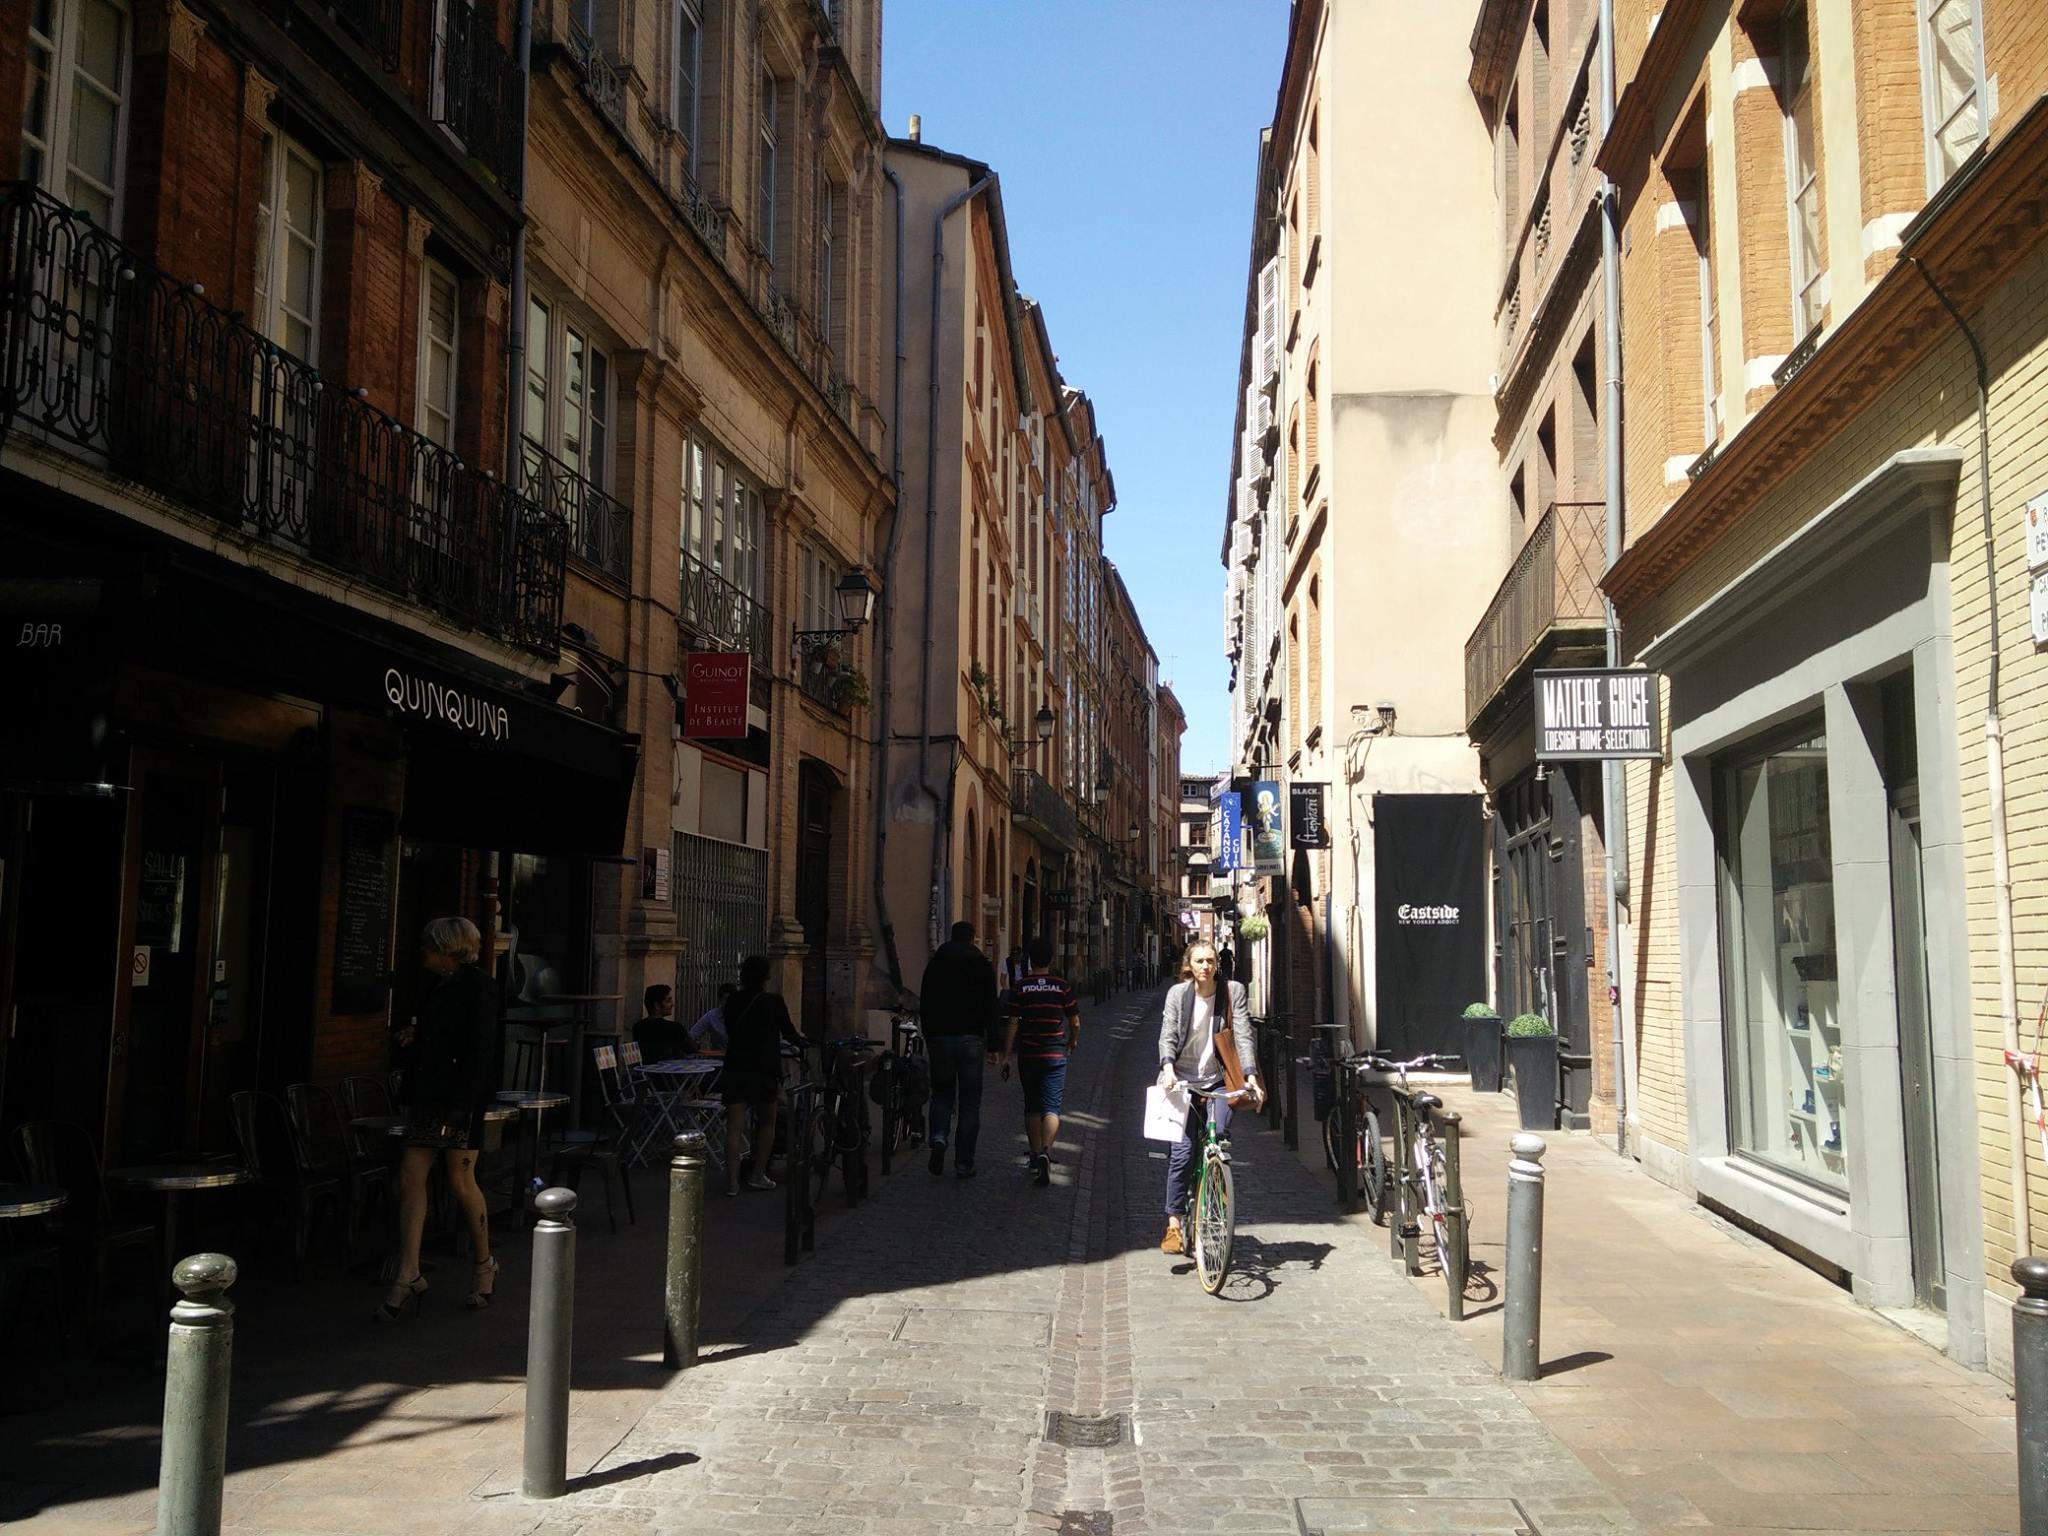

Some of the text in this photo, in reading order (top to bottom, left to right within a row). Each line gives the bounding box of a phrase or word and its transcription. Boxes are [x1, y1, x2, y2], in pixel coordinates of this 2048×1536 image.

[16, 623, 61, 648] BAR
[692, 663, 744, 678] GUINOT
[385, 668, 509, 741] QUINQUINA
[1543, 677, 1650, 729] MATIERE GRISE
[1223, 810, 1231, 868] CAZANOVA
[1232, 838, 1240, 868] CUIR
[1398, 904, 1460, 919] Eastside
[1022, 984, 1063, 993] FIDUCIAL
